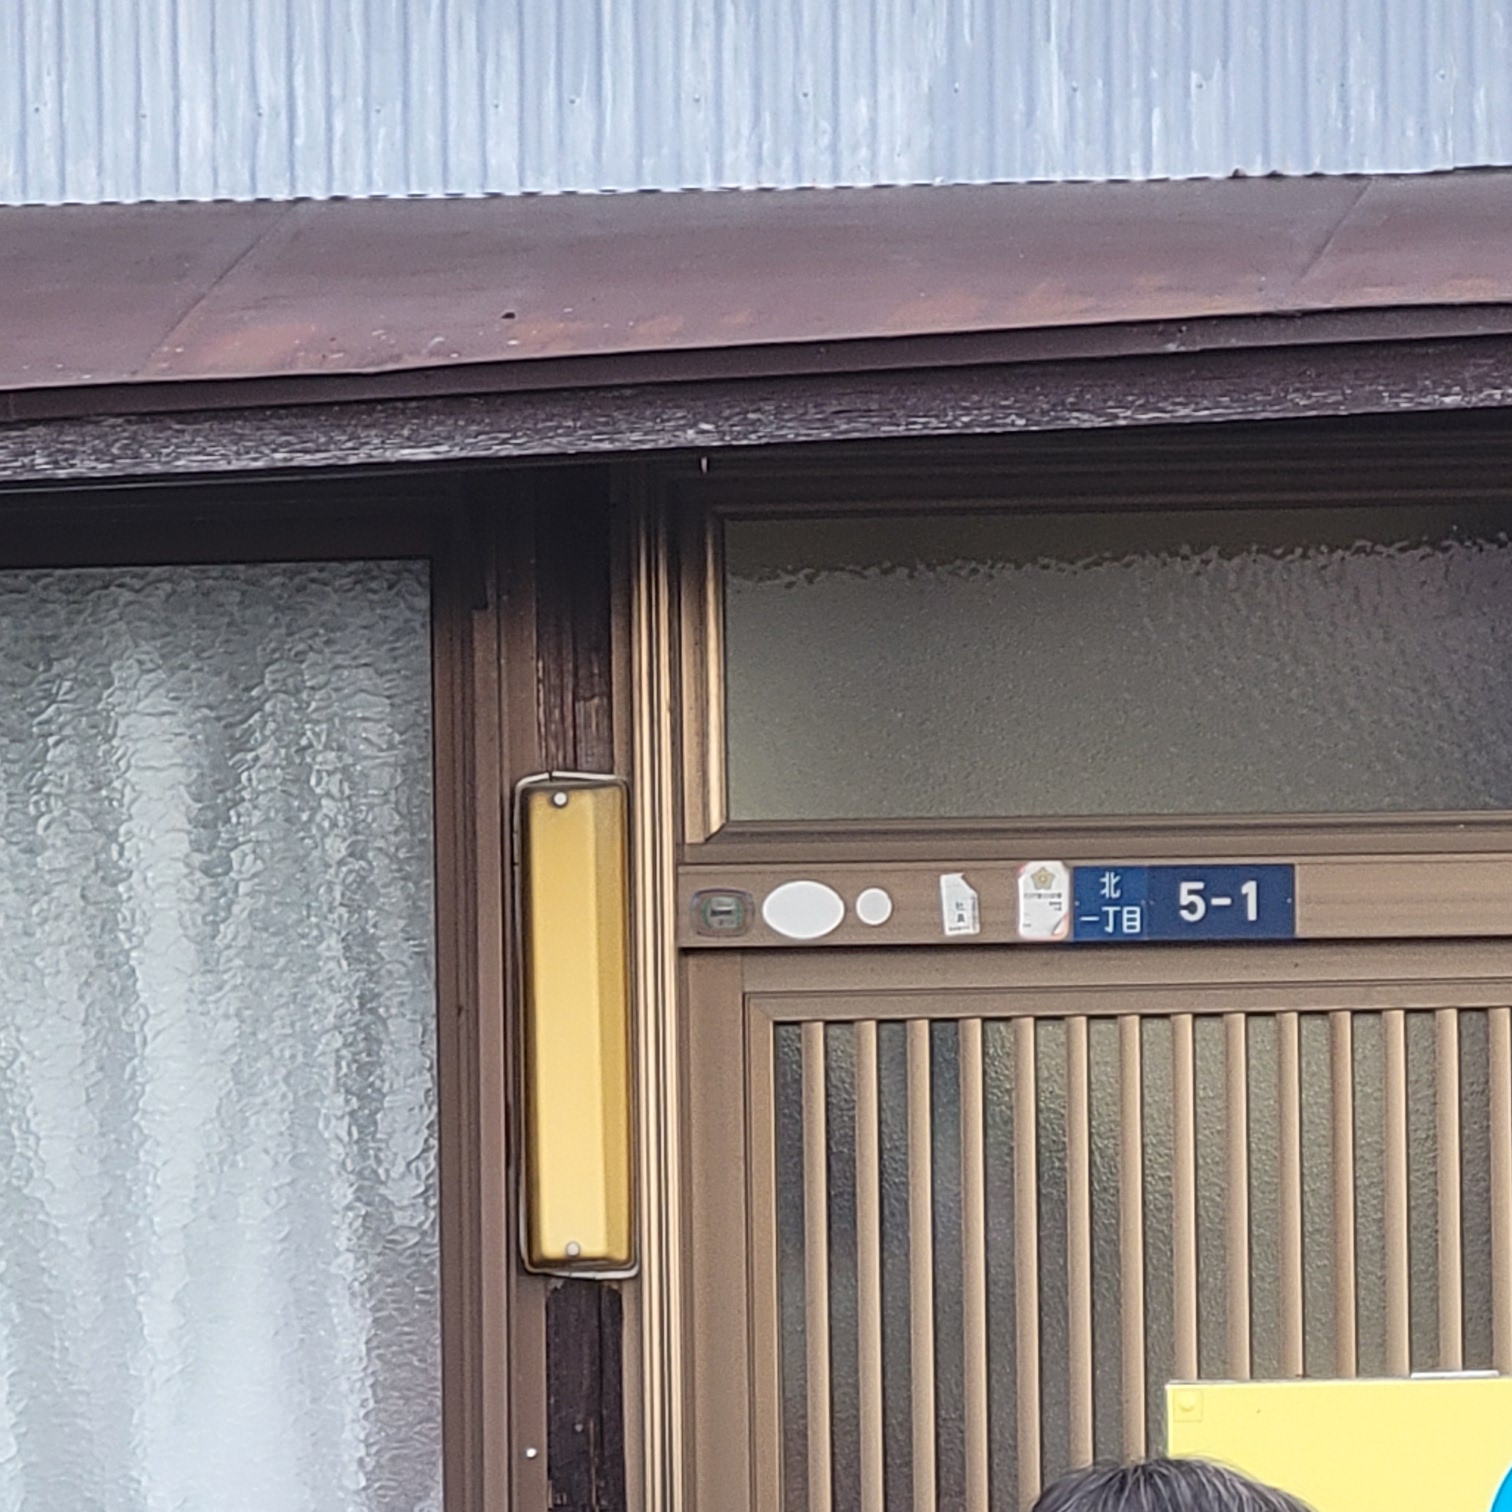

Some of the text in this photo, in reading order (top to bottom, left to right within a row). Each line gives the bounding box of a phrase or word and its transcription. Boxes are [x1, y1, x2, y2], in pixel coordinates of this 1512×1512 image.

[1099, 871, 1121, 899] 北
[1178, 880, 1258, 923] 5-1
[1079, 905, 1141, 934] 一丁目
